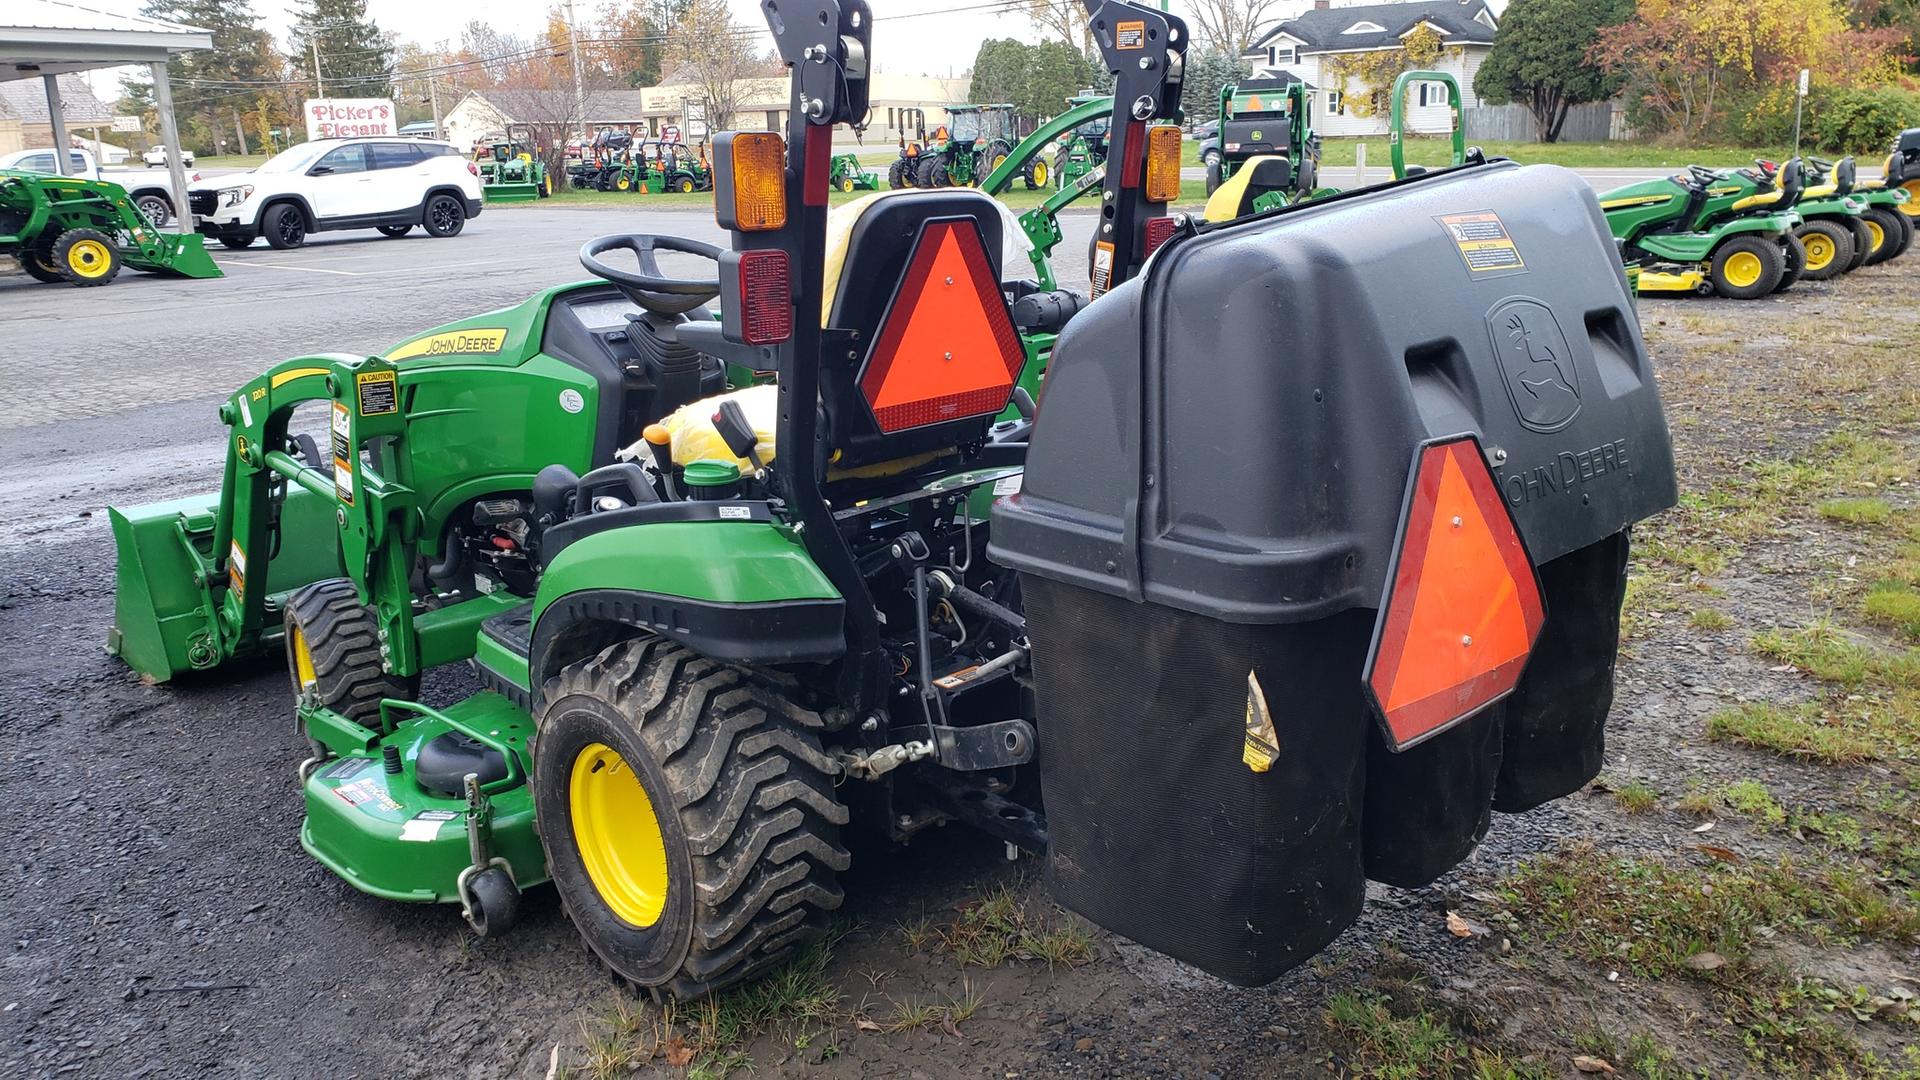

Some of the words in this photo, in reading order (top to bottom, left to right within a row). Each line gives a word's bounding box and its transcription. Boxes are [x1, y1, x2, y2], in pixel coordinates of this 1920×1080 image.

[316, 122, 388, 138] Elegant
[426, 338, 456, 354] JOHN
[457, 335, 497, 351] DEERE
[367, 372, 393, 381] CAUTION
[1557, 438, 1629, 490] DEERE
